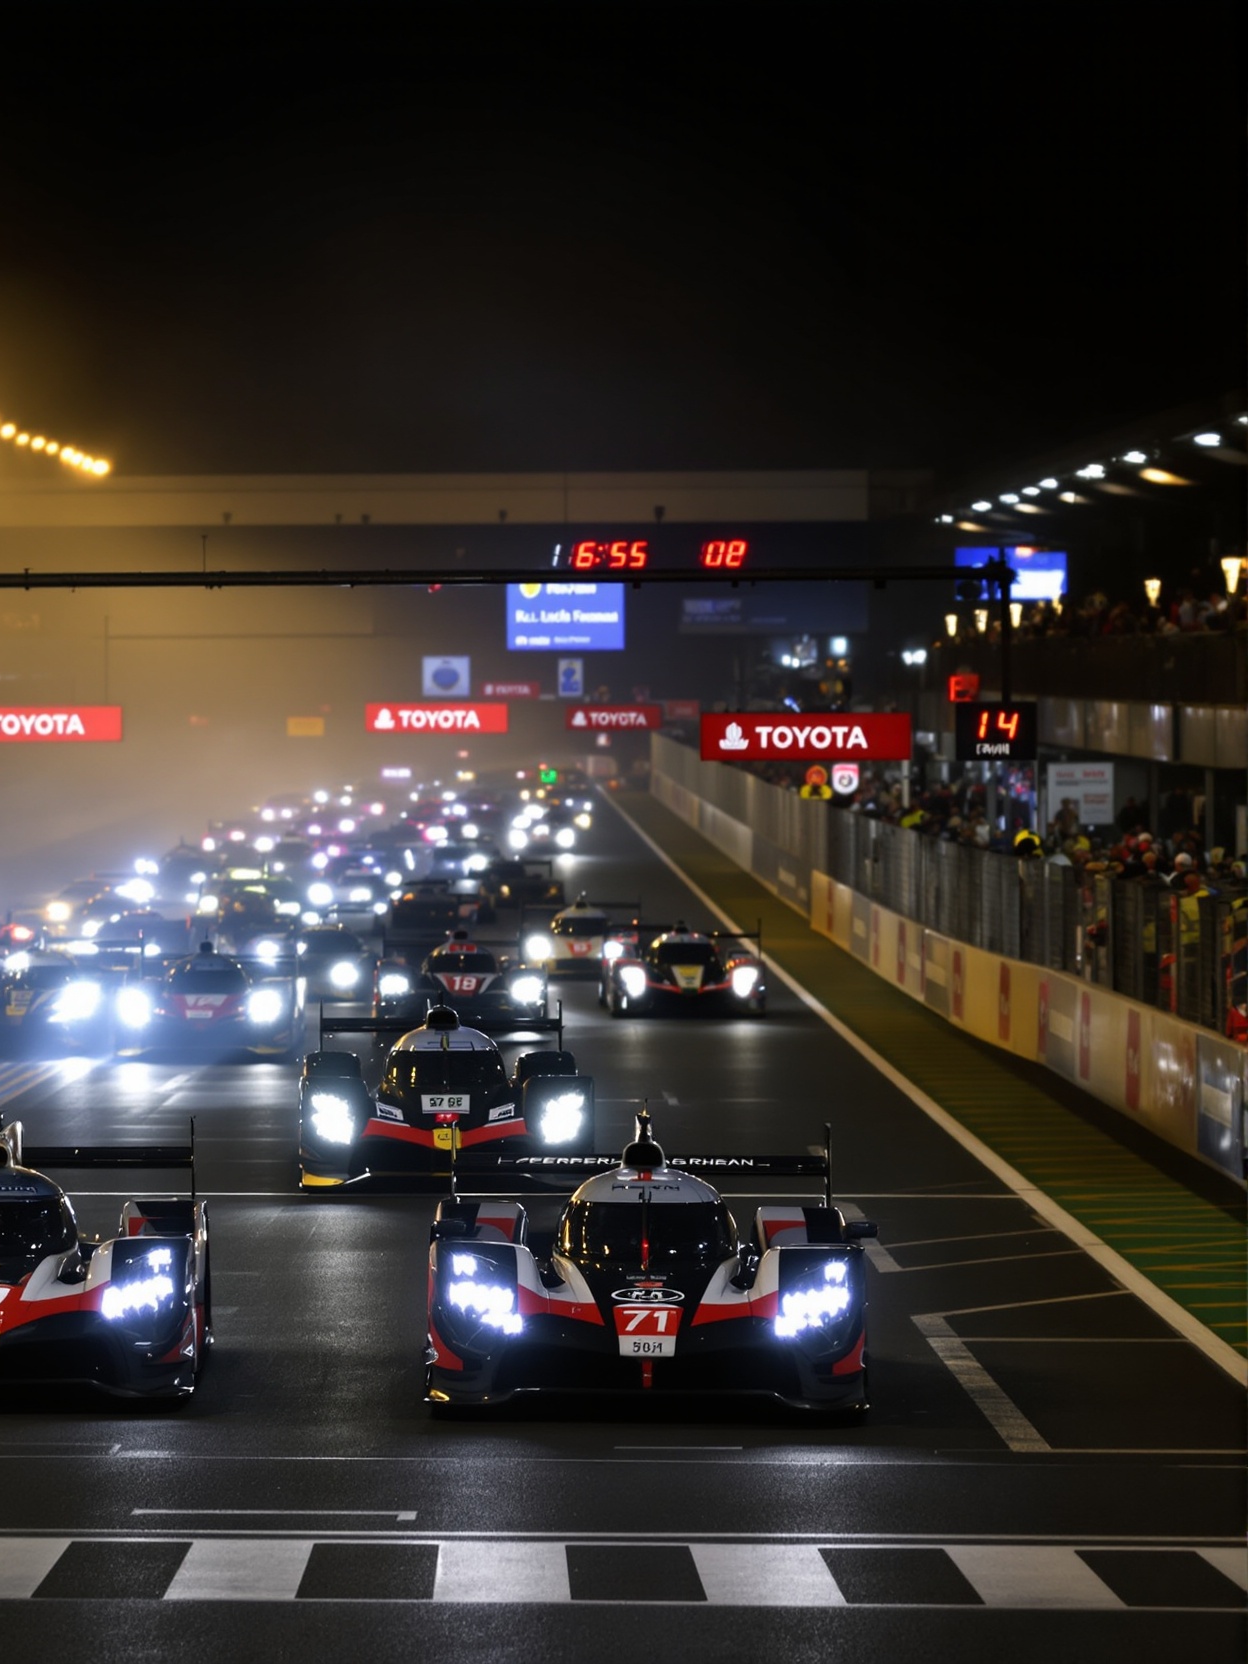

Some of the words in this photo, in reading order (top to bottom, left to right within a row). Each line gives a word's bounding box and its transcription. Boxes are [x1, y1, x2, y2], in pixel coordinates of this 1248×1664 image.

[397, 709, 480, 729] TOYOTA
[589, 712, 647, 727] TOYOTA
[978, 711, 1019, 739] 14
[754, 725, 869, 749] TOYOTA
[623, 1310, 669, 1333] 71
